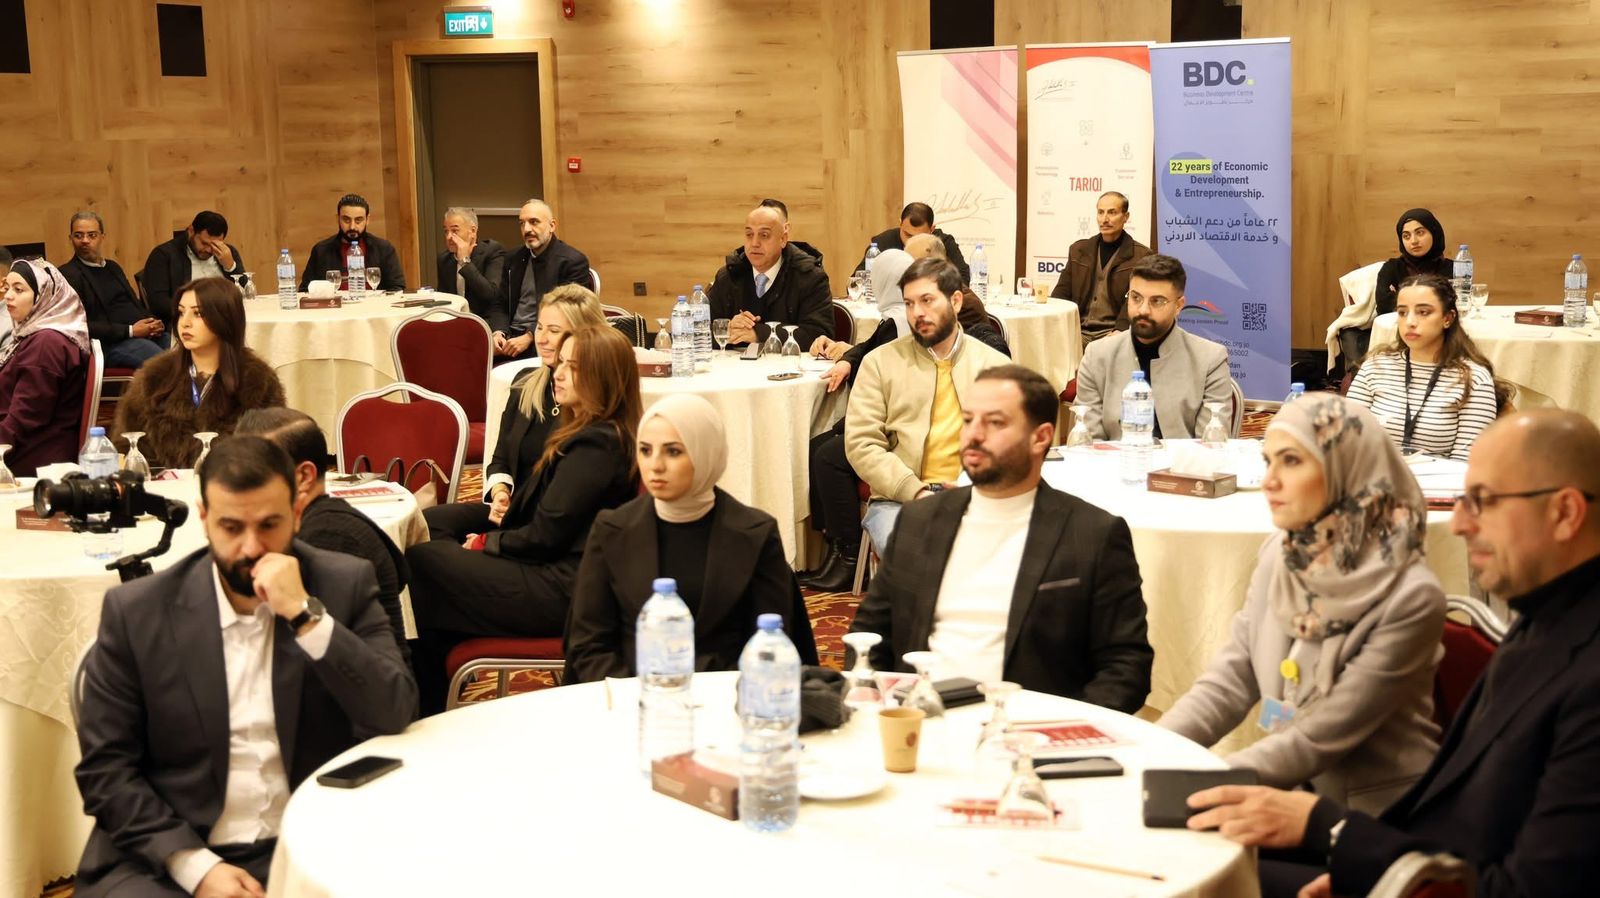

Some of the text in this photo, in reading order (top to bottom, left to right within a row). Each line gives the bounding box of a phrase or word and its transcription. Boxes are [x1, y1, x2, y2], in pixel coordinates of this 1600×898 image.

[449, 19, 465, 32] EXIT
[1171, 161, 1269, 173] 22 years of Economic
[1069, 177, 1103, 192] TARIQI
[1190, 175, 1249, 186] Development
[1175, 188, 1265, 200] & Entrepreneurship.
[1165, 214, 1202, 228] الشباب
[1204, 218, 1224, 229] دعم
[1226, 218, 1241, 229] من
[1199, 231, 1241, 241] الاقتصاد
[1243, 231, 1269, 242] خدمة
[1272, 235, 1279, 244] و
